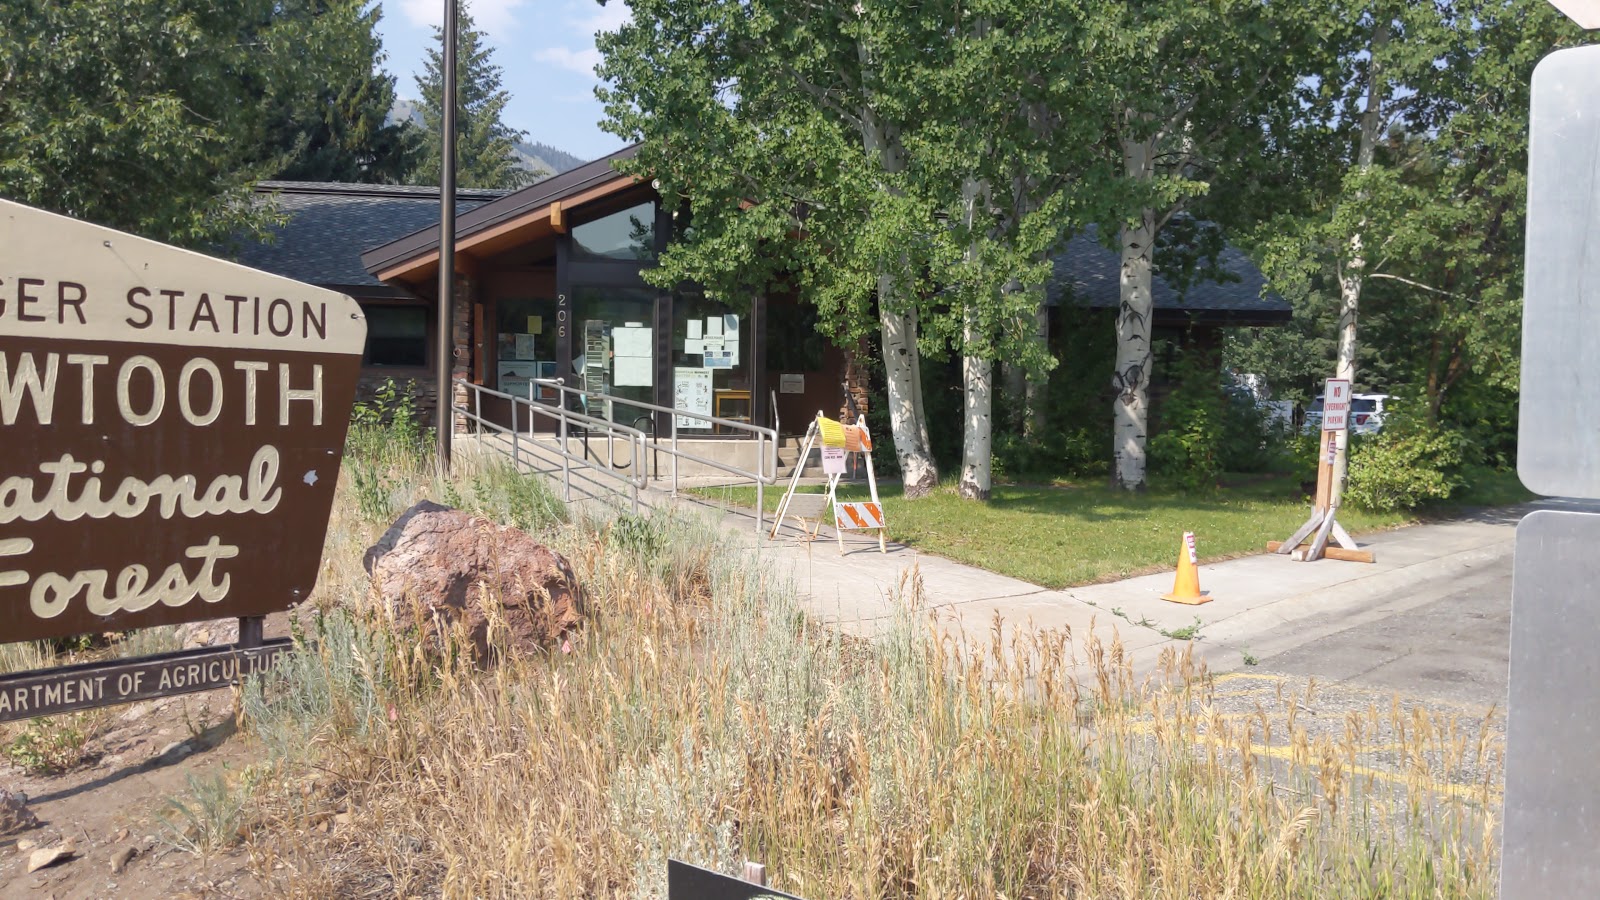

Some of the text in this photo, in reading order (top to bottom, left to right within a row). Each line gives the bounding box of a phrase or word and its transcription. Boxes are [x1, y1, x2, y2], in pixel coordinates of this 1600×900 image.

[126, 286, 327, 340] STATION
[557, 294, 566, 338] 206
[0, 351, 323, 427] WTOOTH
[1325, 402, 1347, 411] OVERNIGHT
[1333, 386, 1342, 398] NO
[1327, 416, 1343, 424] PARKING
[0, 676, 107, 713] ARTMENT
[118, 671, 146, 696] OF
